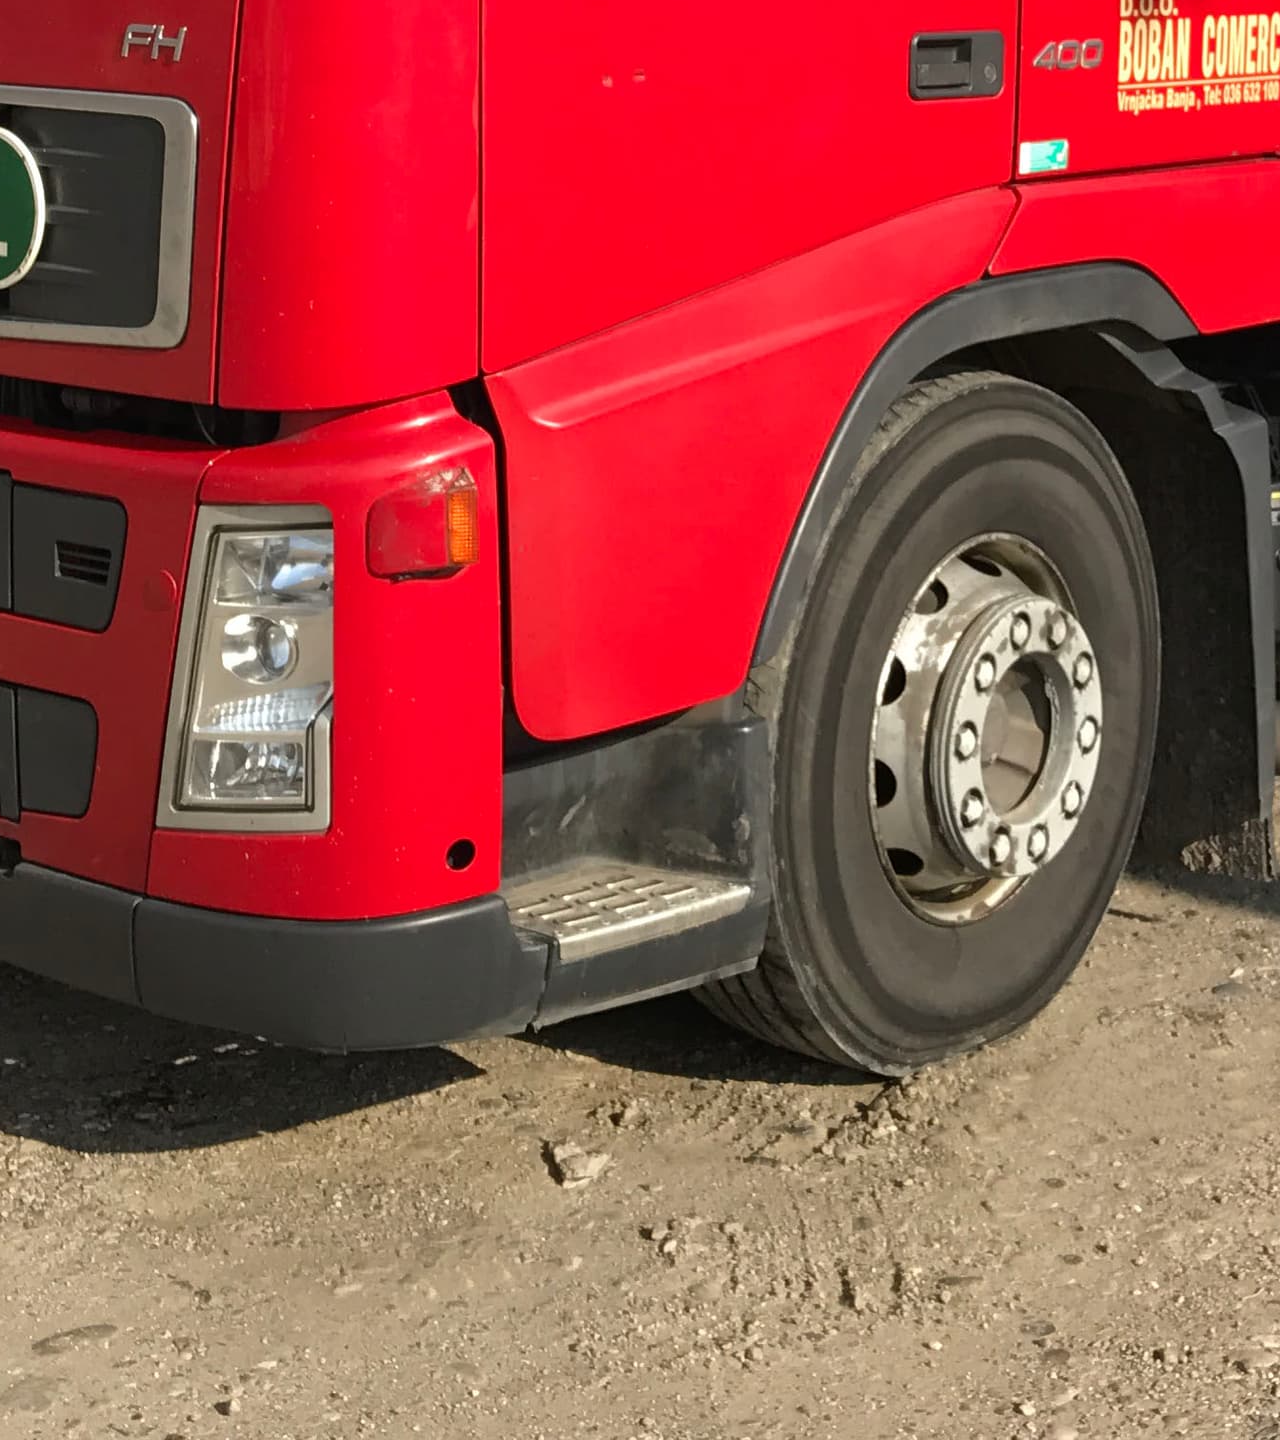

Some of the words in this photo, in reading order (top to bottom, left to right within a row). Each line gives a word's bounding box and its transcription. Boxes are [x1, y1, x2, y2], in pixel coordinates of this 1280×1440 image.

[121, 24, 187, 63] FH
[1032, 38, 1104, 71] 400
[1118, 17, 1191, 83] BOBAN
[1117, 89, 1164, 116] Vrnjačka
[1223, 83, 1241, 104] 036
[1243, 81, 1261, 103] 632
[1263, 80, 1280, 101] 100
